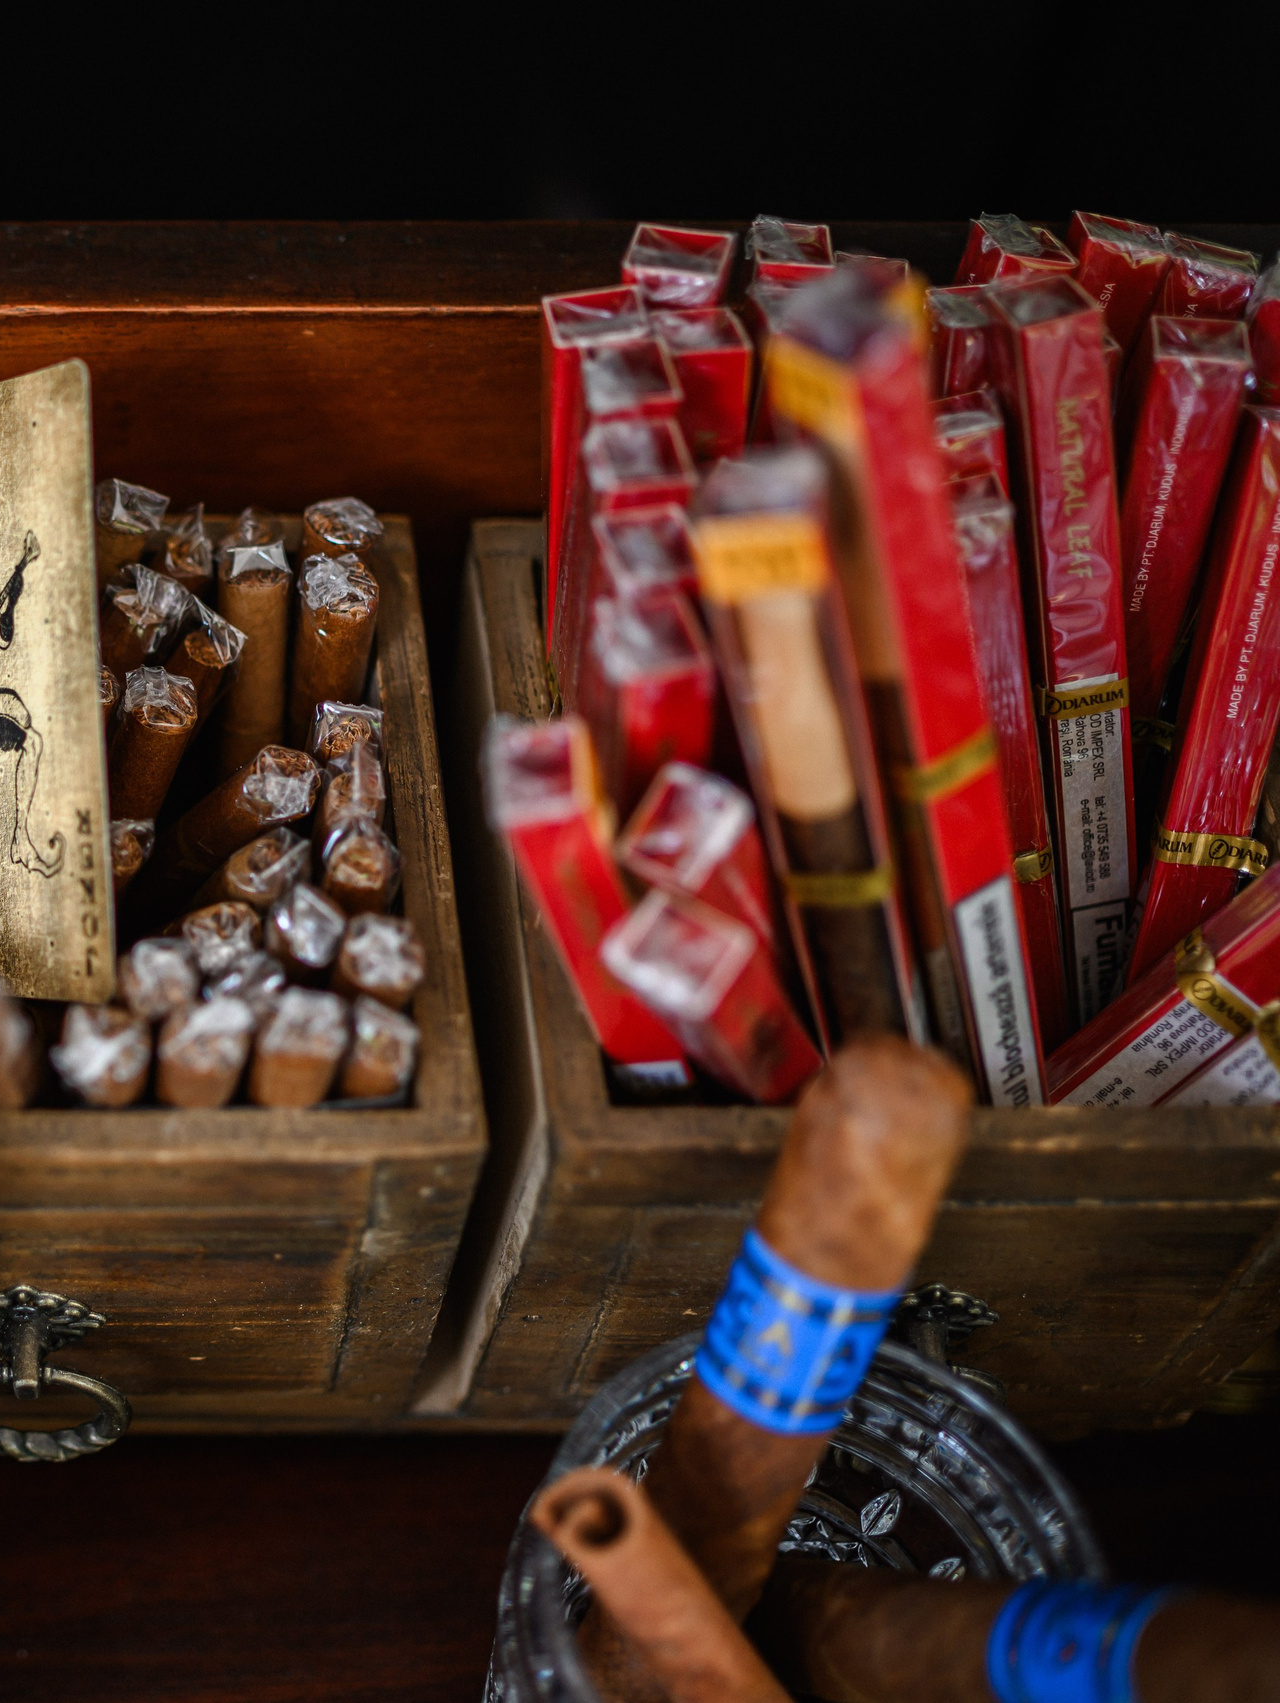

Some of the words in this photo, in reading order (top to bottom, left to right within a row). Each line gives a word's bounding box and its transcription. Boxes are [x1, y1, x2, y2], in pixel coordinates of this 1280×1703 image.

[1158, 462, 1177, 501] KUDUS
[1146, 503, 1168, 549] DJARUM,
[1067, 523, 1094, 579] LEAF
[1142, 549, 1154, 567] PT.
[1258, 543, 1279, 587] KUDUS
[1137, 567, 1149, 582] BY
[1129, 583, 1147, 612] MADE
[1240, 646, 1254, 664] PT.
[1235, 665, 1249, 683] BY
[1226, 684, 1244, 719] MADE
[1091, 730, 1104, 761] IMPEX
[1093, 762, 1106, 781] SRL
[1164, 1035, 1200, 1064] IMPEX
[1145, 1060, 1169, 1077] SRL
